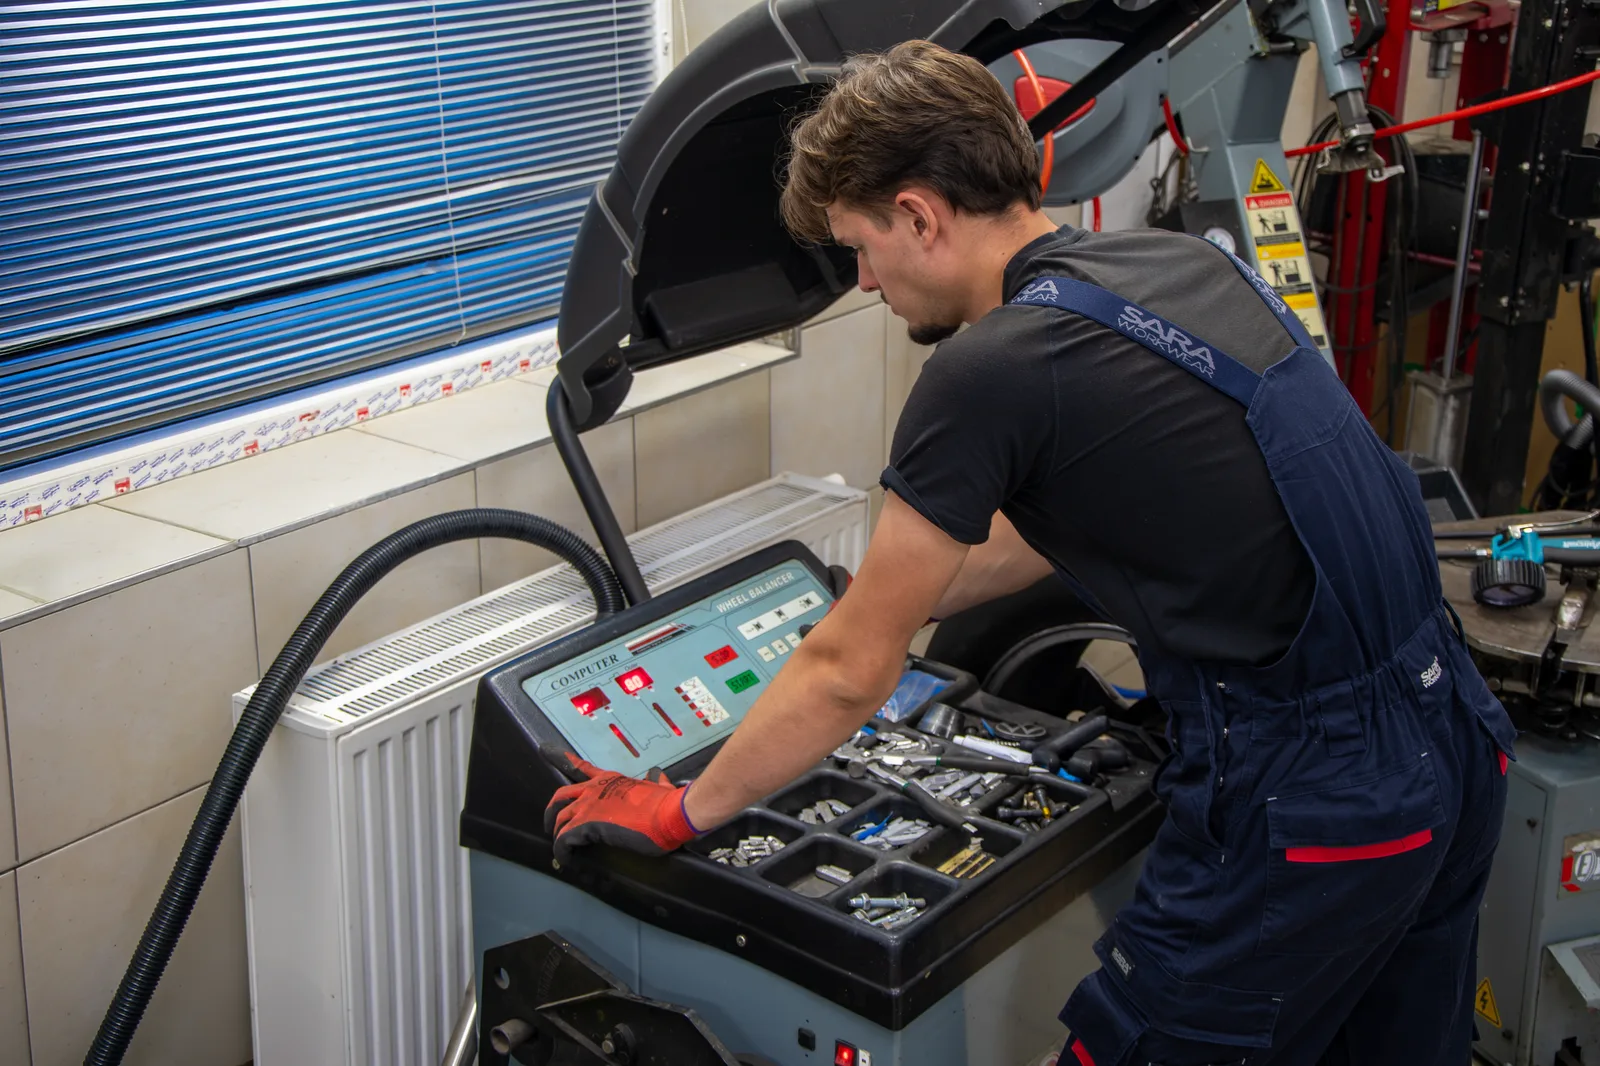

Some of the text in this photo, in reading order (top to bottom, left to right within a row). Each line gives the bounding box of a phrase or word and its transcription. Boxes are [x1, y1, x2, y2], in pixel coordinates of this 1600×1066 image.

[1117, 317, 1214, 379] WORKWEAR
[1119, 305, 1216, 370] SARA
[716, 571, 795, 613] WHEEL BALANCER
[550, 653, 619, 691] COMPUTER
[730, 673, 754, 691] START
